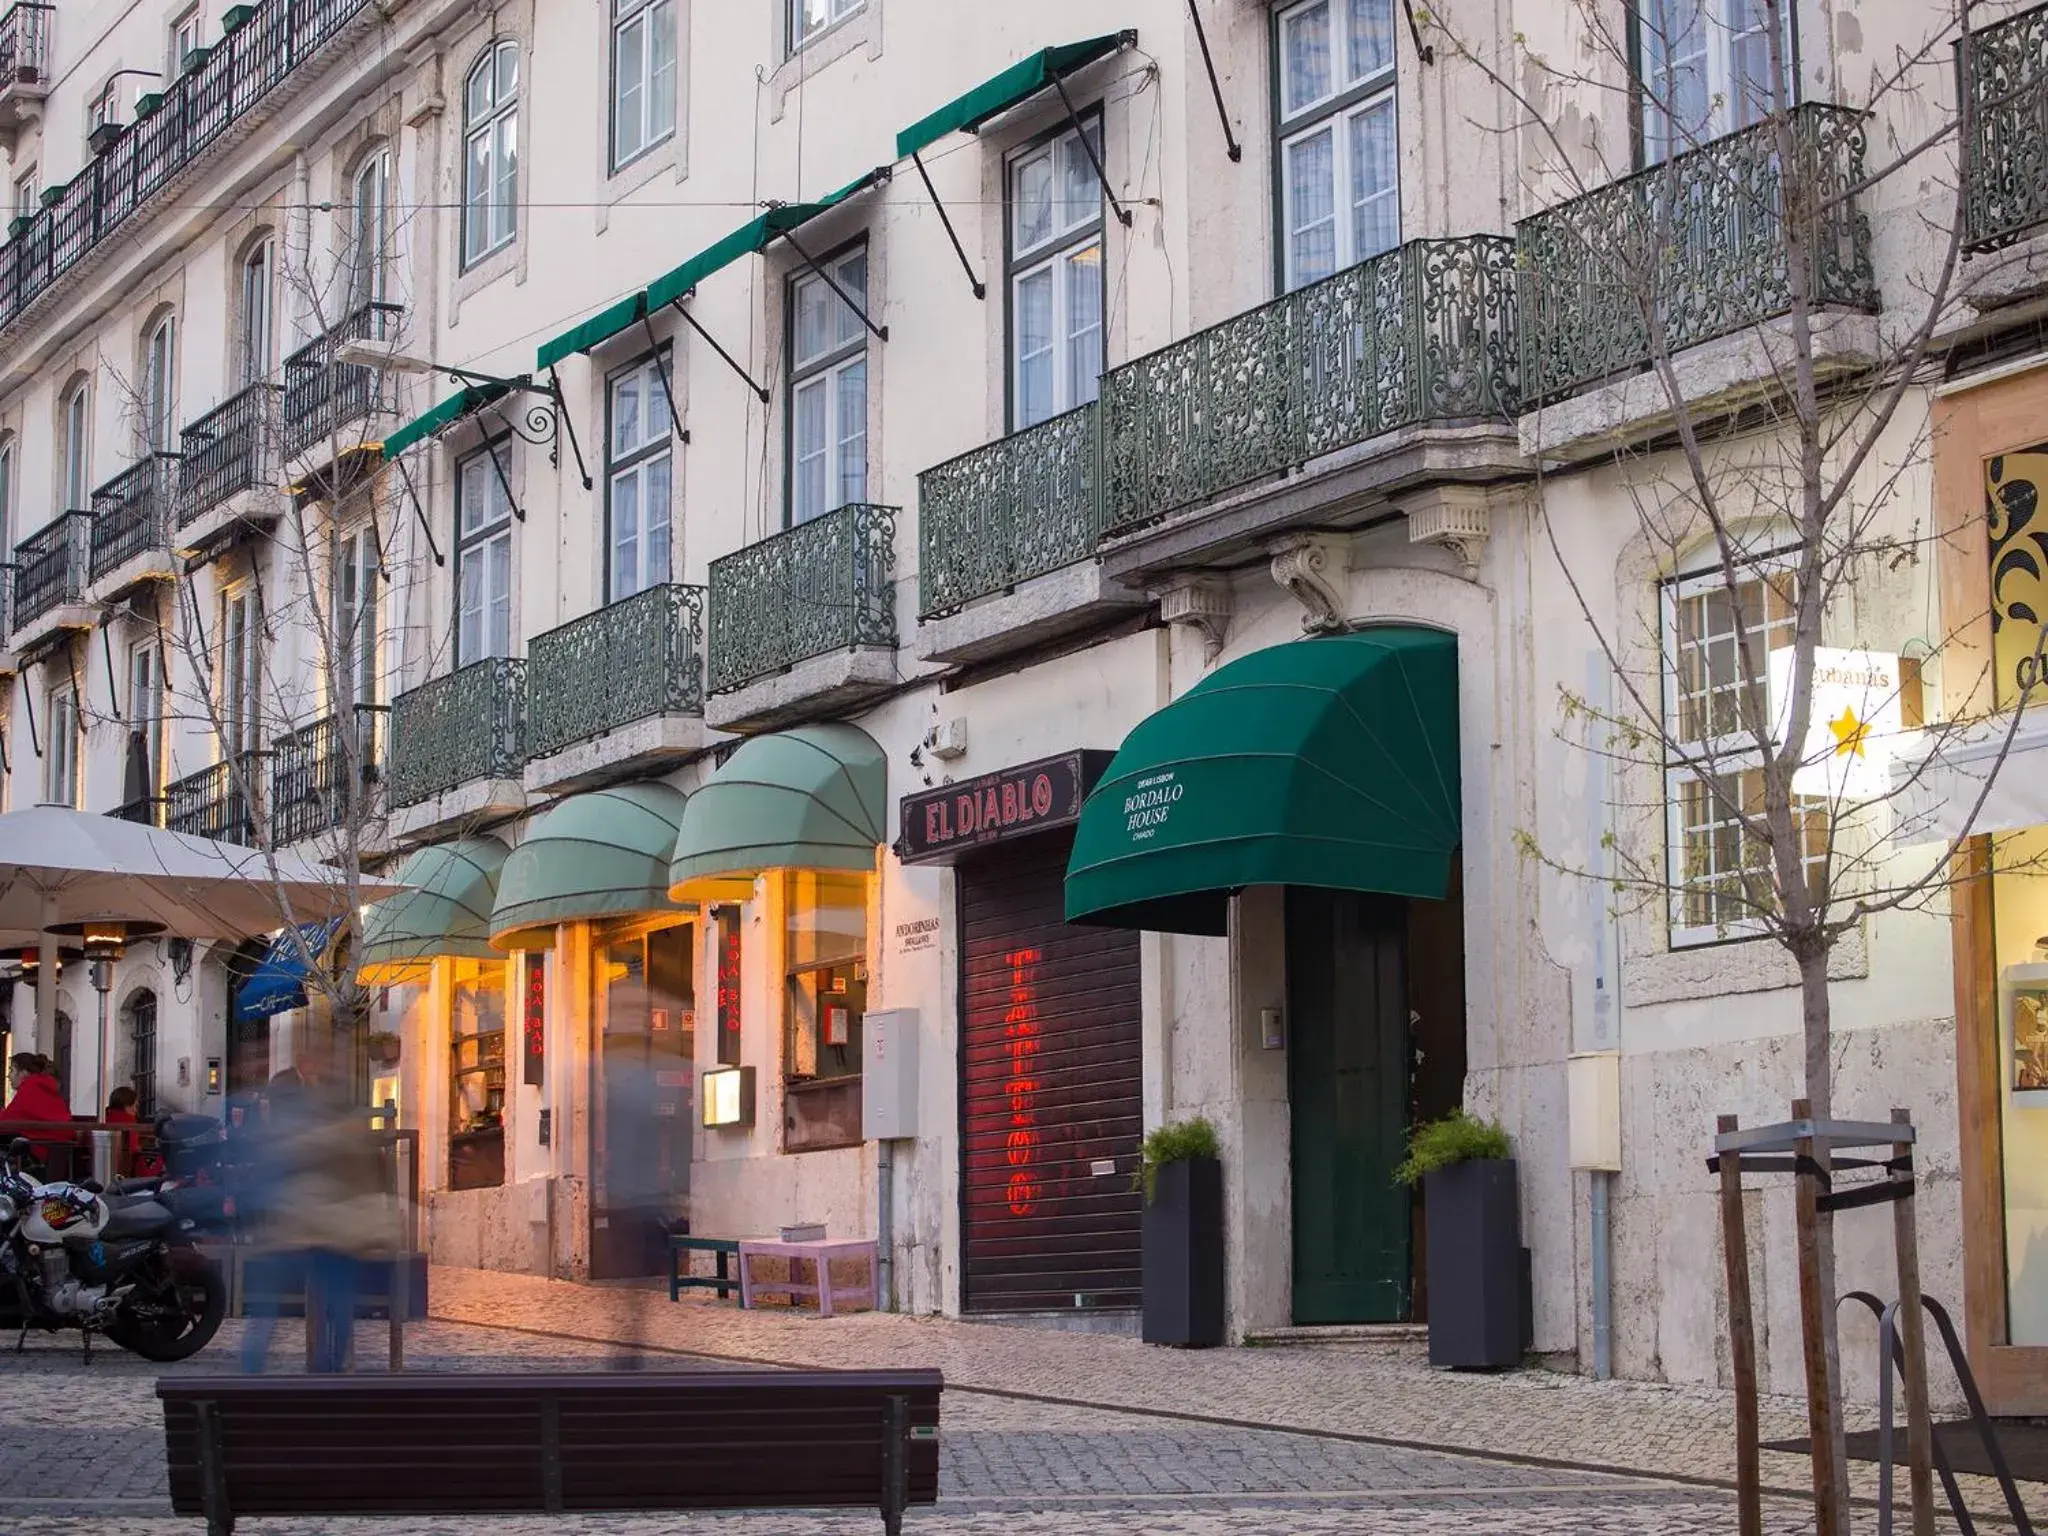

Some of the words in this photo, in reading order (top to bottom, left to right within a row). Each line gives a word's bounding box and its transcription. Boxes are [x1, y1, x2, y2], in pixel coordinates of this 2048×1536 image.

[925, 800, 954, 844] EL
[956, 773, 1052, 836] DIABLO
[1123, 784, 1183, 814] BORDALO
[1127, 806, 1169, 831] HOUSE
